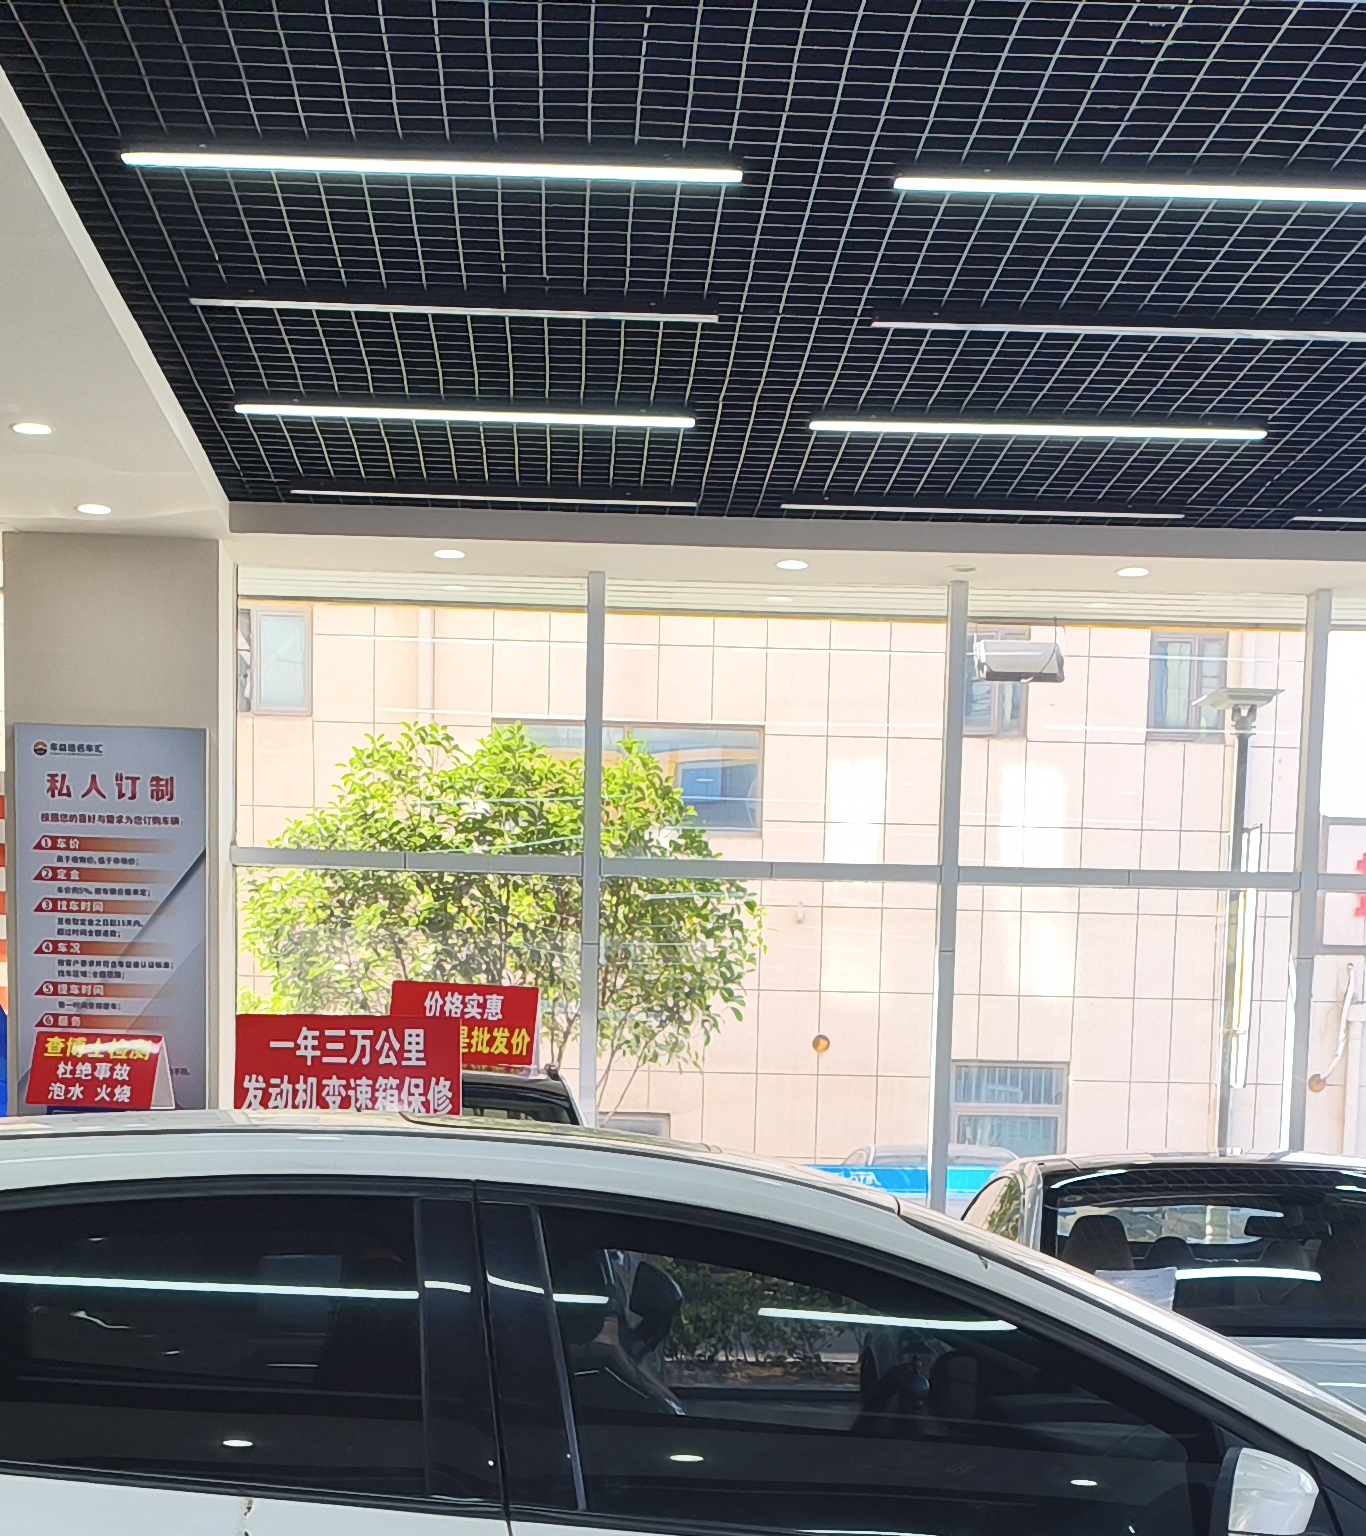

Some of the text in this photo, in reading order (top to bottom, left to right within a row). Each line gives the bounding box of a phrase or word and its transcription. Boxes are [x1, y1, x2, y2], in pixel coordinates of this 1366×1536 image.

[46, 773, 175, 801] 私人订制
[424, 990, 504, 1020] 价格实惠
[269, 1026, 427, 1066] 一年三万公里
[56, 1061, 131, 1081] 杜绝事故
[48, 1082, 132, 1103] 泡水 火烧
[241, 1075, 453, 1115] 发动机变速箱保修
